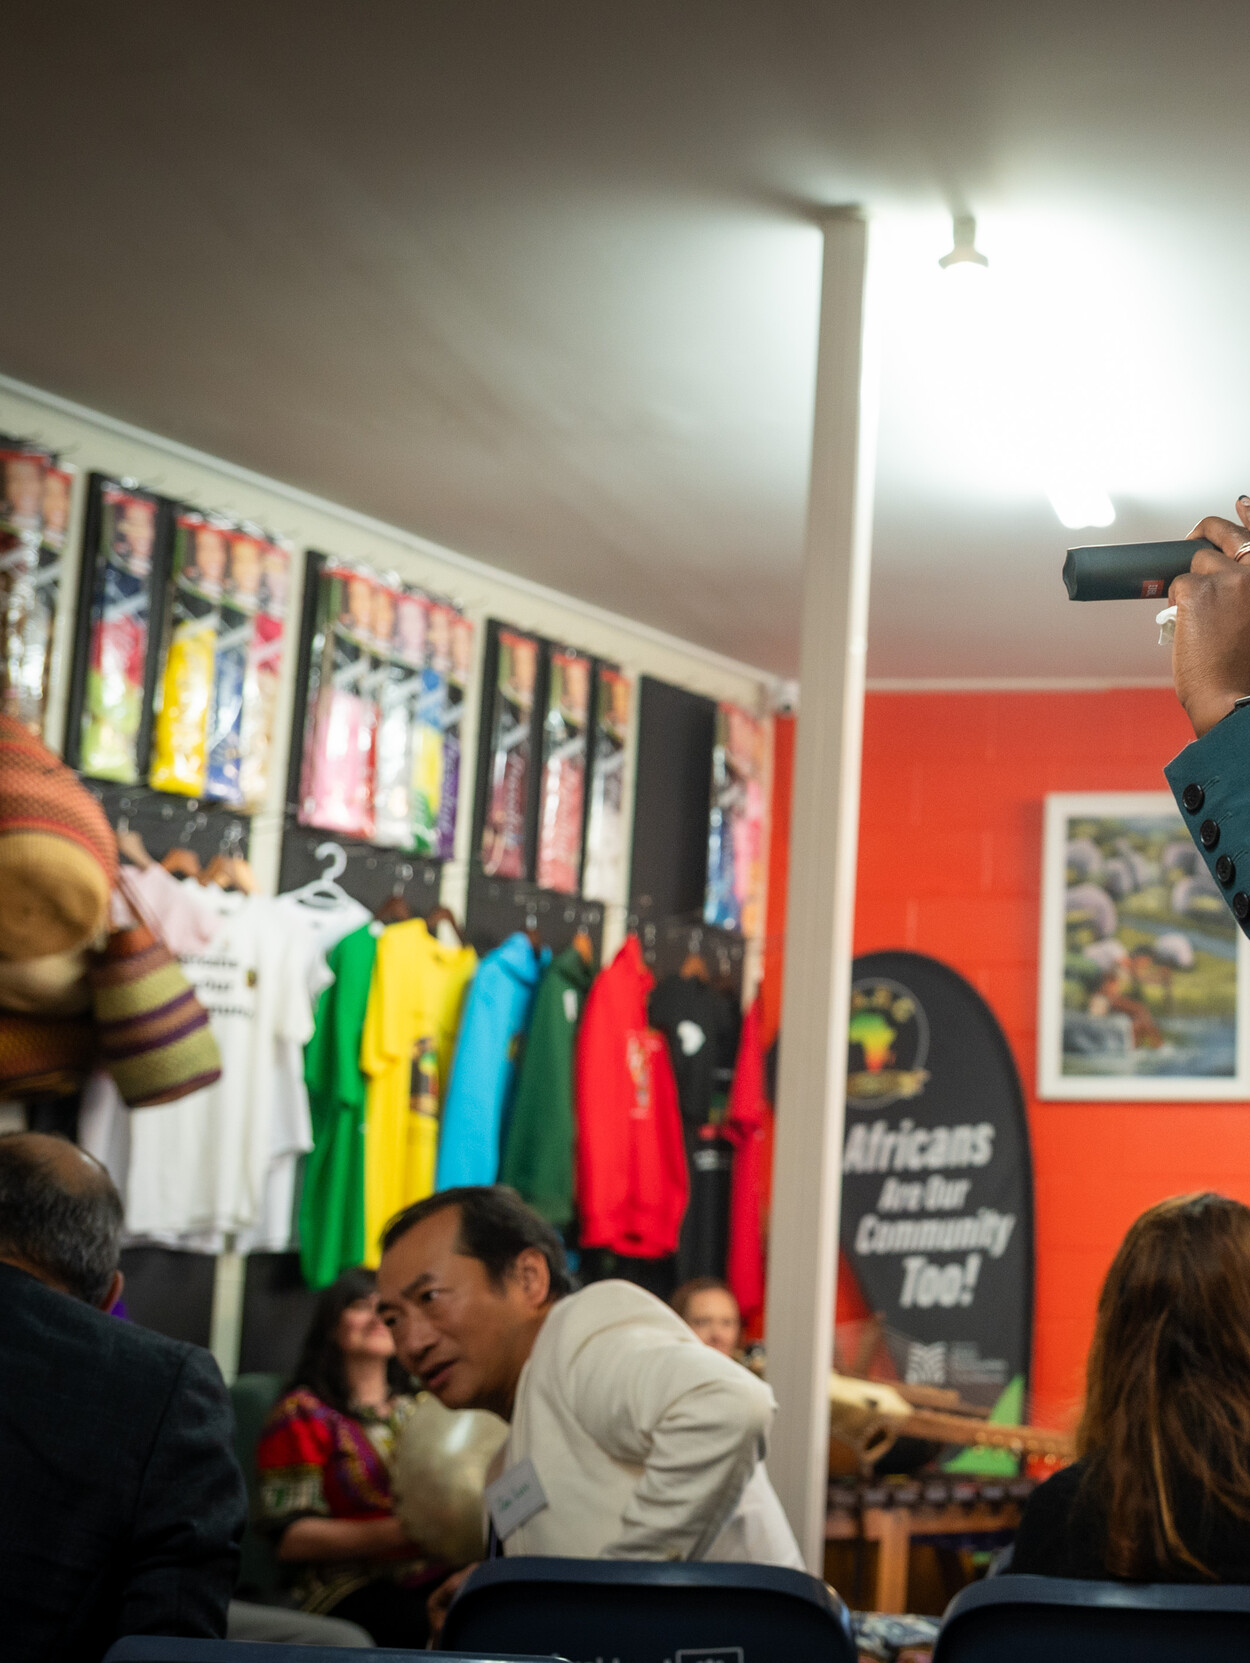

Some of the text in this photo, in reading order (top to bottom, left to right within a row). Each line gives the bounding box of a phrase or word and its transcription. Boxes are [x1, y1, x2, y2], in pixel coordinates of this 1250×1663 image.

[843, 1118, 995, 1173] Africans
[877, 1173, 972, 1214] Are Our
[855, 1207, 1015, 1258] Community
[901, 1252, 982, 1309] Too!
